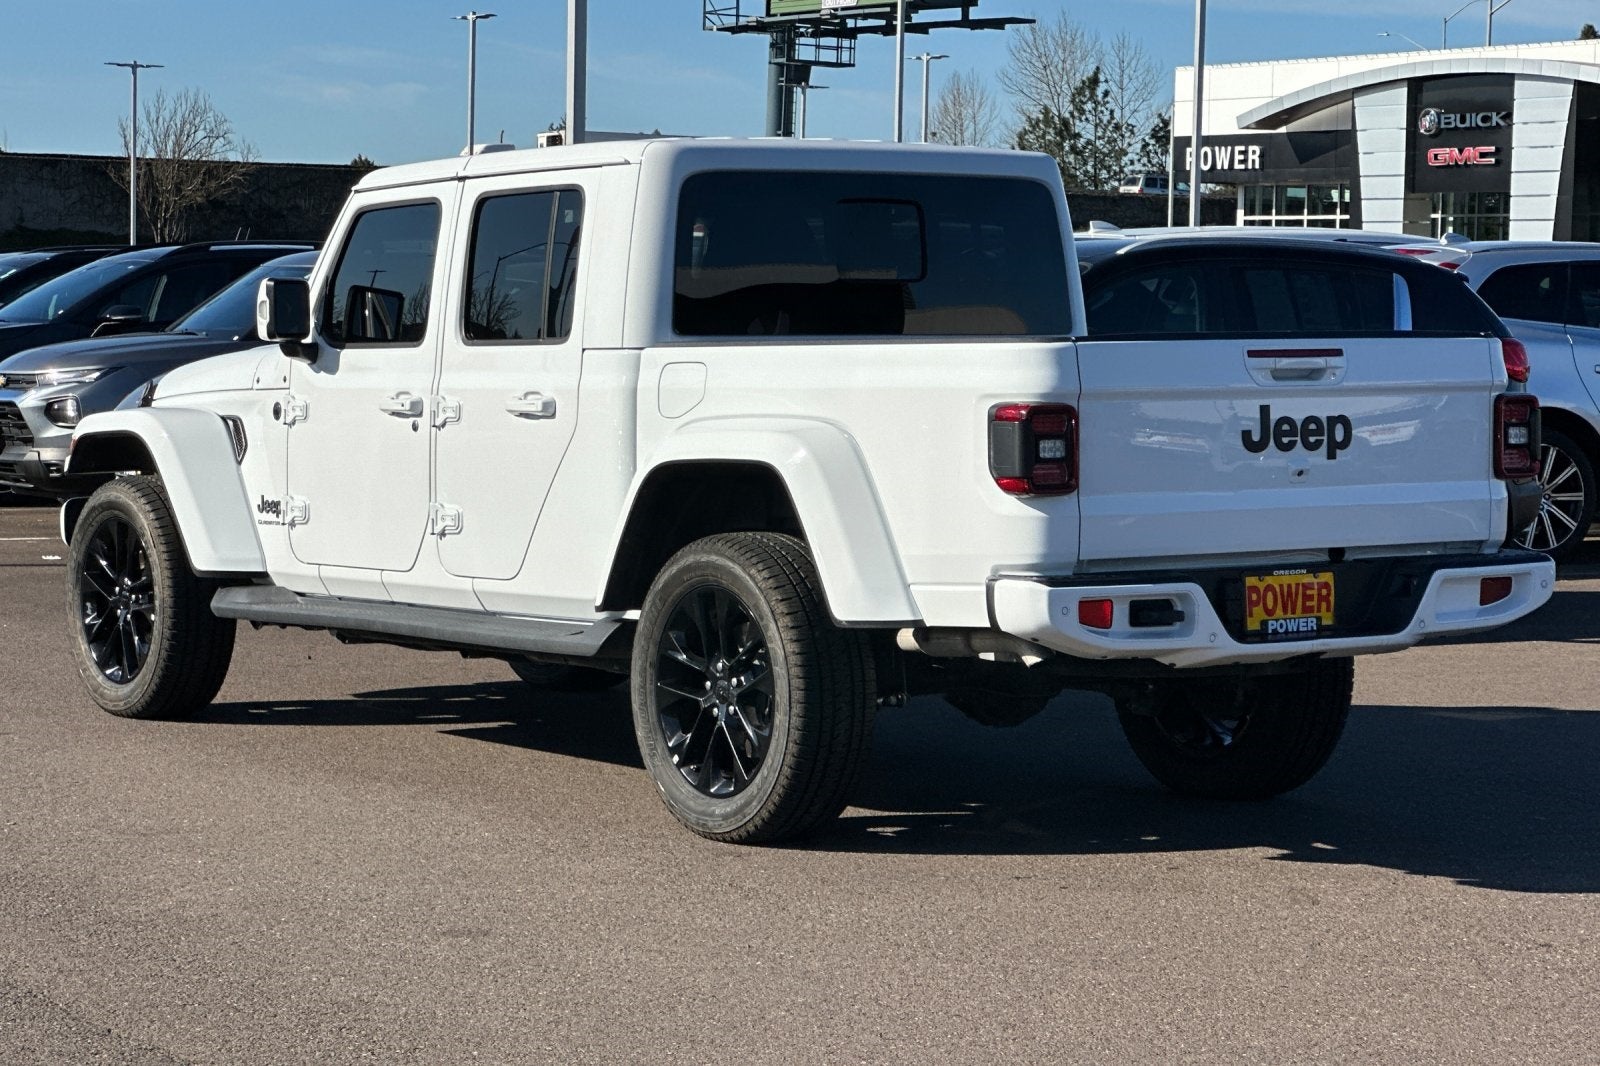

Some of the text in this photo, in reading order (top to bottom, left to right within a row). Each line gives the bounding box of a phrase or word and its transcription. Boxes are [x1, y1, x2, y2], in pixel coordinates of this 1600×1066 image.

[1440, 112, 1508, 129] BUICK
[1427, 146, 1496, 166] GMC
[1241, 405, 1353, 460] Jeep
[257, 495, 281, 519] Jeep
[1247, 581, 1332, 618] POWER
[1268, 617, 1317, 634] POWER
